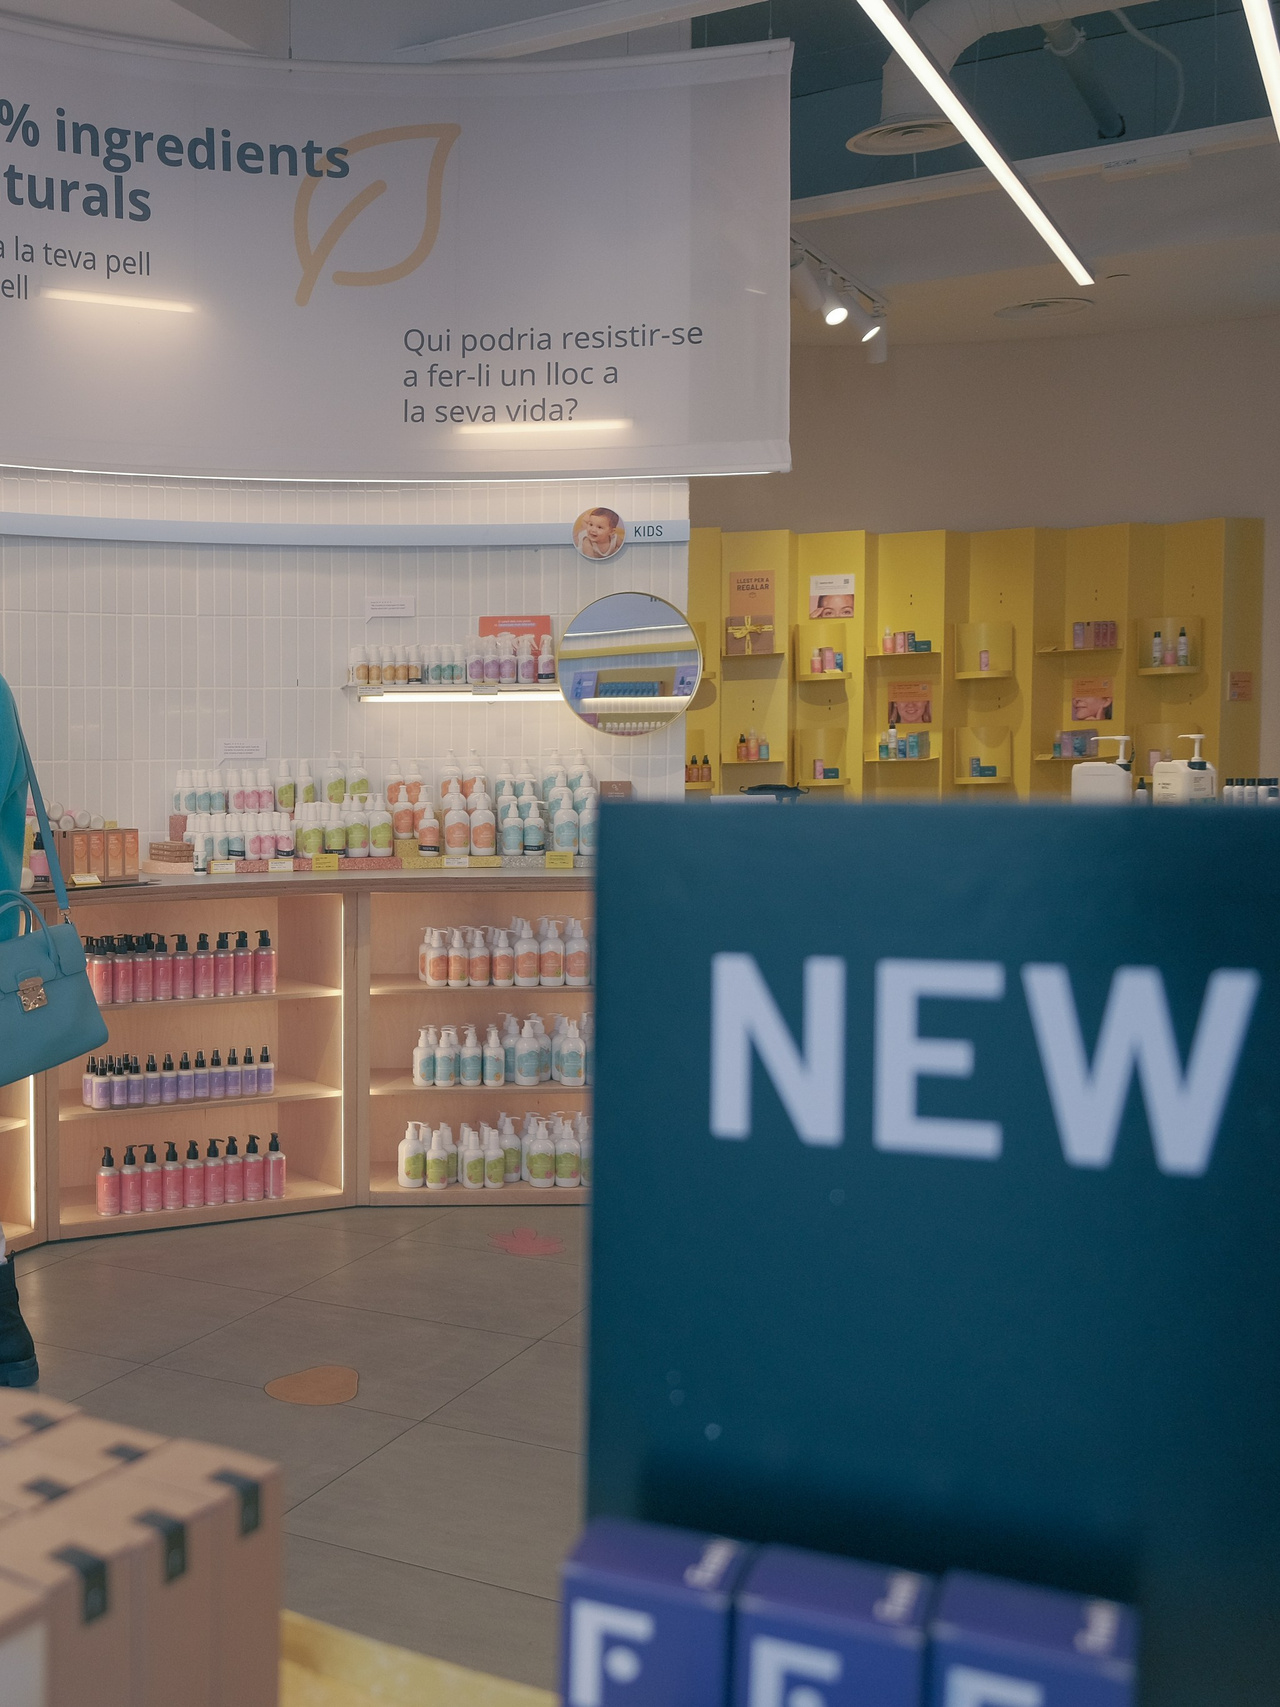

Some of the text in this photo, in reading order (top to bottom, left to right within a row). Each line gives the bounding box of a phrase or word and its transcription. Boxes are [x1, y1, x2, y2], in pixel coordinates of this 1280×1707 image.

[55, 107, 350, 179] ingredients
[14, 234, 35, 263] la
[42, 241, 97, 270] teva
[105, 250, 151, 280] pell
[403, 322, 704, 360] Qui podria resistir-se
[402, 361, 619, 388] a fer-li un lloc a
[403, 396, 579, 424] la seva vida?
[634, 525, 663, 537] KIDS
[709, 951, 1261, 1178] NEW
